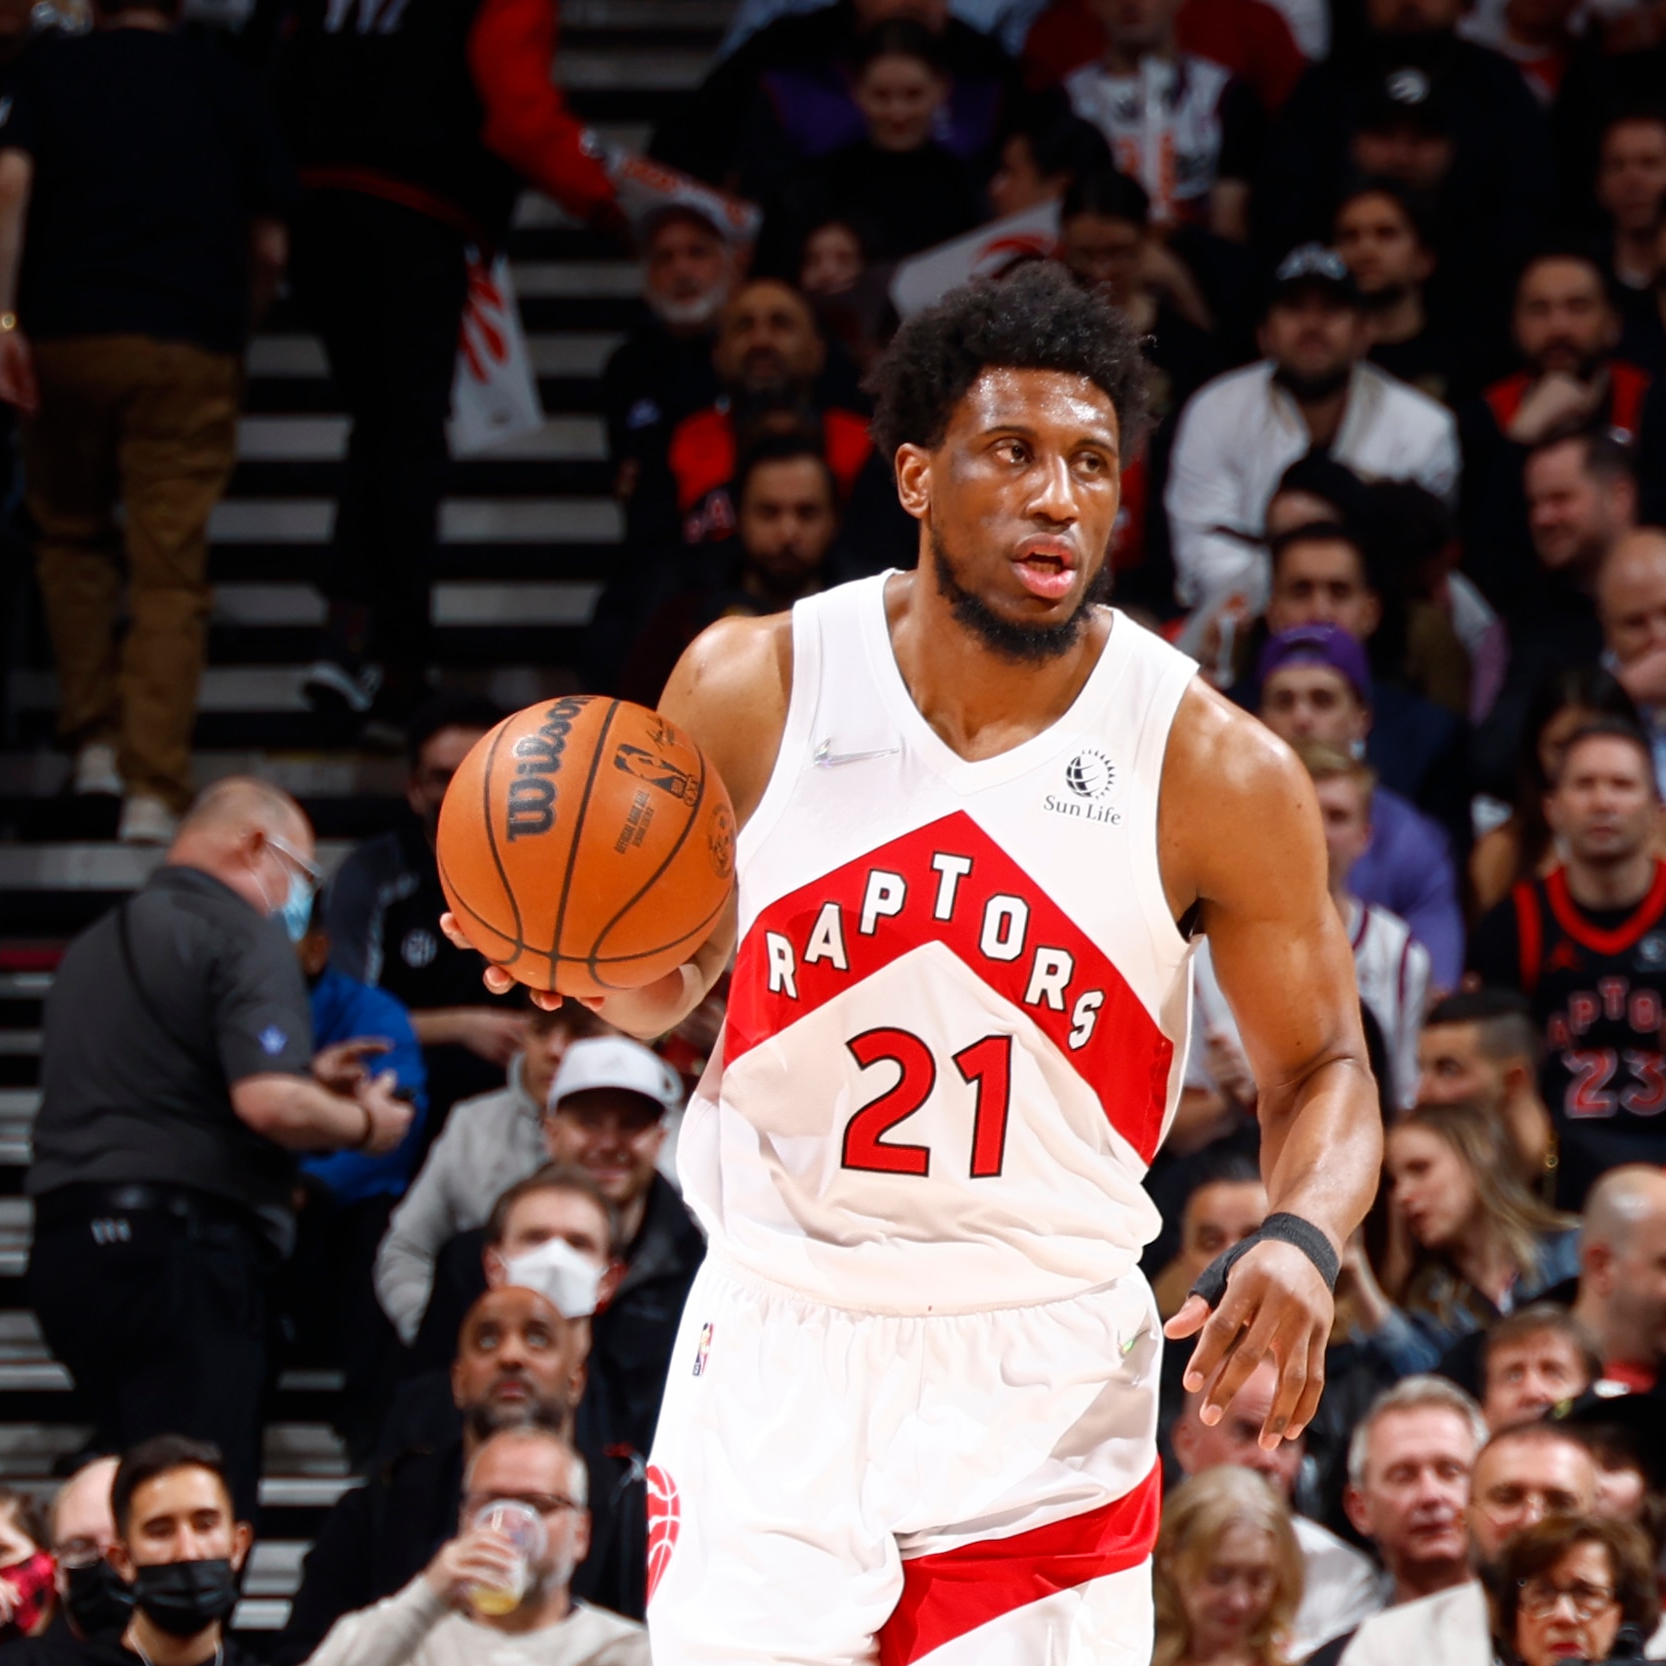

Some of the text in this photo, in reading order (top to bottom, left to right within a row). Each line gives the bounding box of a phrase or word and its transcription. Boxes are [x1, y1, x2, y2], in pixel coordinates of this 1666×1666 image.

[507, 697, 595, 842] Wilson
[1044, 794, 1122, 826] Sun Life
[765, 850, 1106, 1052] RAPTORS
[841, 1025, 1013, 1179] 21
